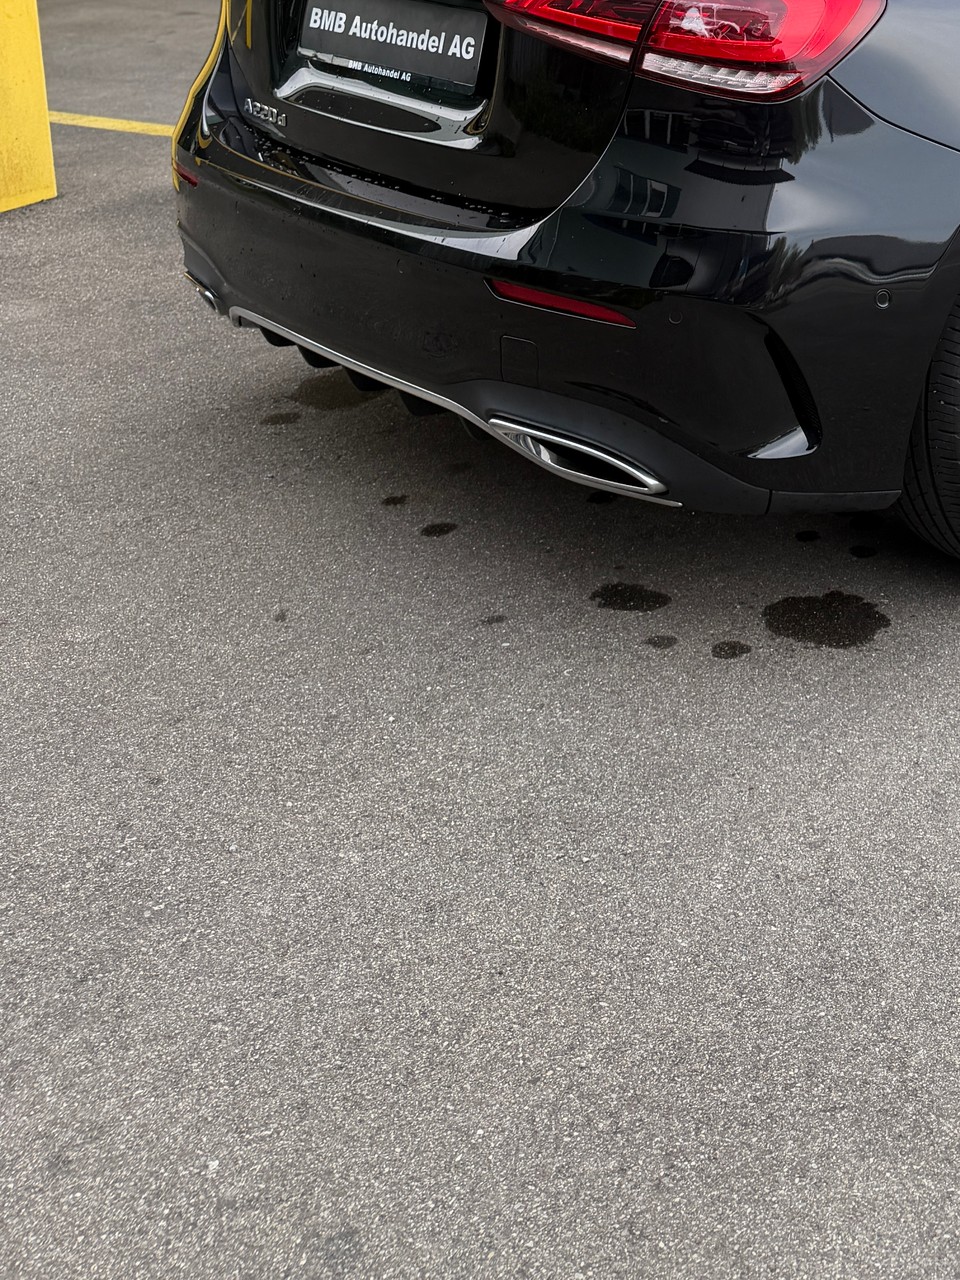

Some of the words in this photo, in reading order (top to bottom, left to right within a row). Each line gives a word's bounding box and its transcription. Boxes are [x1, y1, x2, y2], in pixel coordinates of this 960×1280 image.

[309, 7, 347, 34] BMB
[348, 15, 446, 54] Autohandel
[447, 34, 475, 60] AG
[348, 60, 362, 70] BMB
[363, 64, 401, 79] Autohandel
[401, 72, 411, 81] AG
